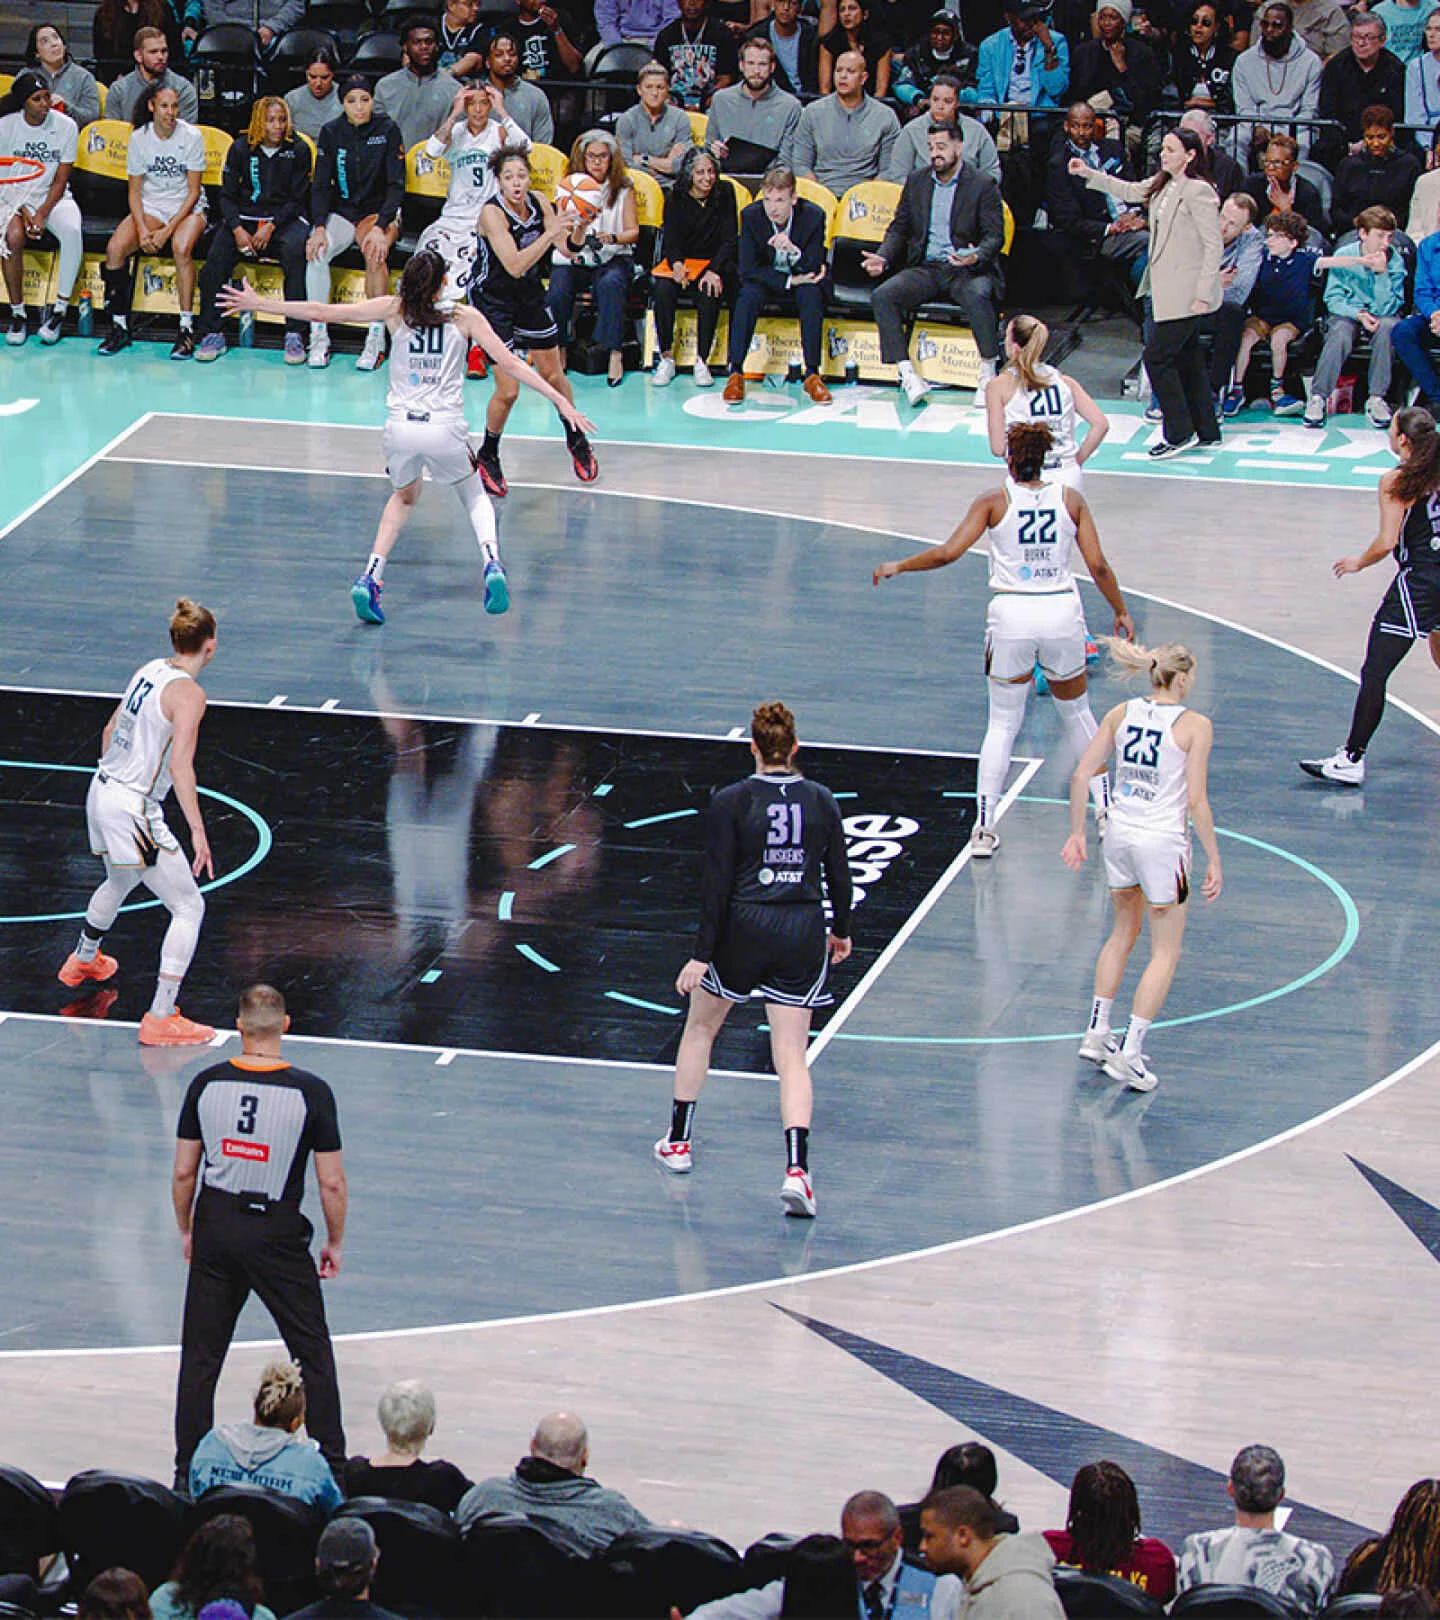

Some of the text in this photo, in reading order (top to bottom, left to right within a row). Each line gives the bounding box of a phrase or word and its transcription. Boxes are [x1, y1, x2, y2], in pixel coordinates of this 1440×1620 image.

[24, 142, 49, 151] NO
[472, 167, 484, 187] 9
[408, 322, 444, 353] 30
[1028, 384, 1062, 417] 20
[1018, 509, 1057, 544] 22
[126, 677, 154, 715] 13
[1123, 724, 1162, 767] 23
[766, 803, 802, 845] 31
[775, 871, 804, 883] AT&T
[237, 1095, 259, 1134] 3
[210, 1466, 244, 1481] NEW
